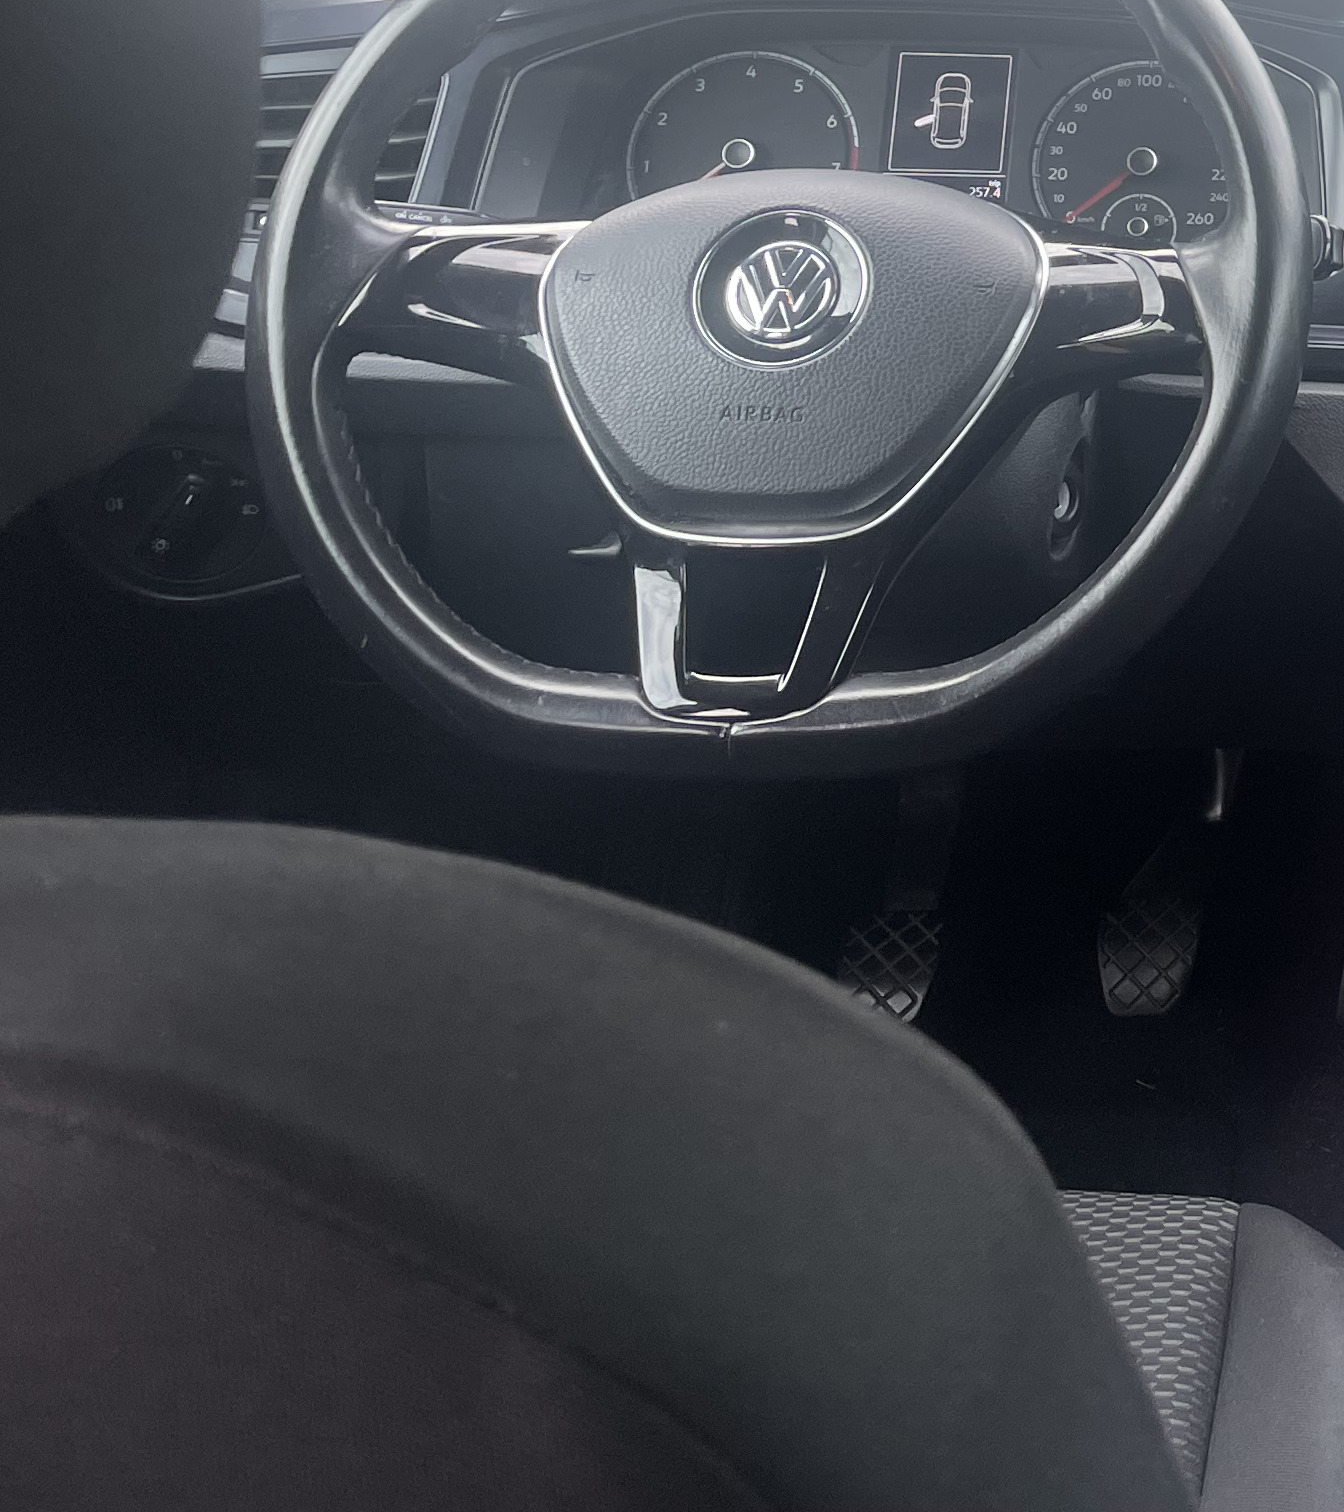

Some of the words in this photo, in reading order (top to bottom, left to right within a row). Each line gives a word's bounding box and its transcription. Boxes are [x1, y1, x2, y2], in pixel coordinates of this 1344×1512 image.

[745, 65, 757, 78] 4
[695, 78, 705, 92] 3
[793, 79, 804, 93] 5
[1117, 78, 1131, 87] 80
[1136, 74, 1162, 87] 100
[1091, 87, 1112, 101] 60
[1074, 103, 1088, 113] 50
[656, 112, 668, 126] 2
[826, 114, 837, 128] 6
[1056, 121, 1077, 134] 40
[1049, 146, 1063, 155] 30
[644, 160, 650, 173] 1
[1047, 167, 1068, 181] 20
[1211, 169, 1226, 181] 22
[968, 186, 1001, 199] 257.4
[1053, 193, 1065, 203] 10
[1135, 203, 1147, 212] 1/2
[1186, 212, 1214, 225] 260
[719, 404, 804, 424] AIRBAG
